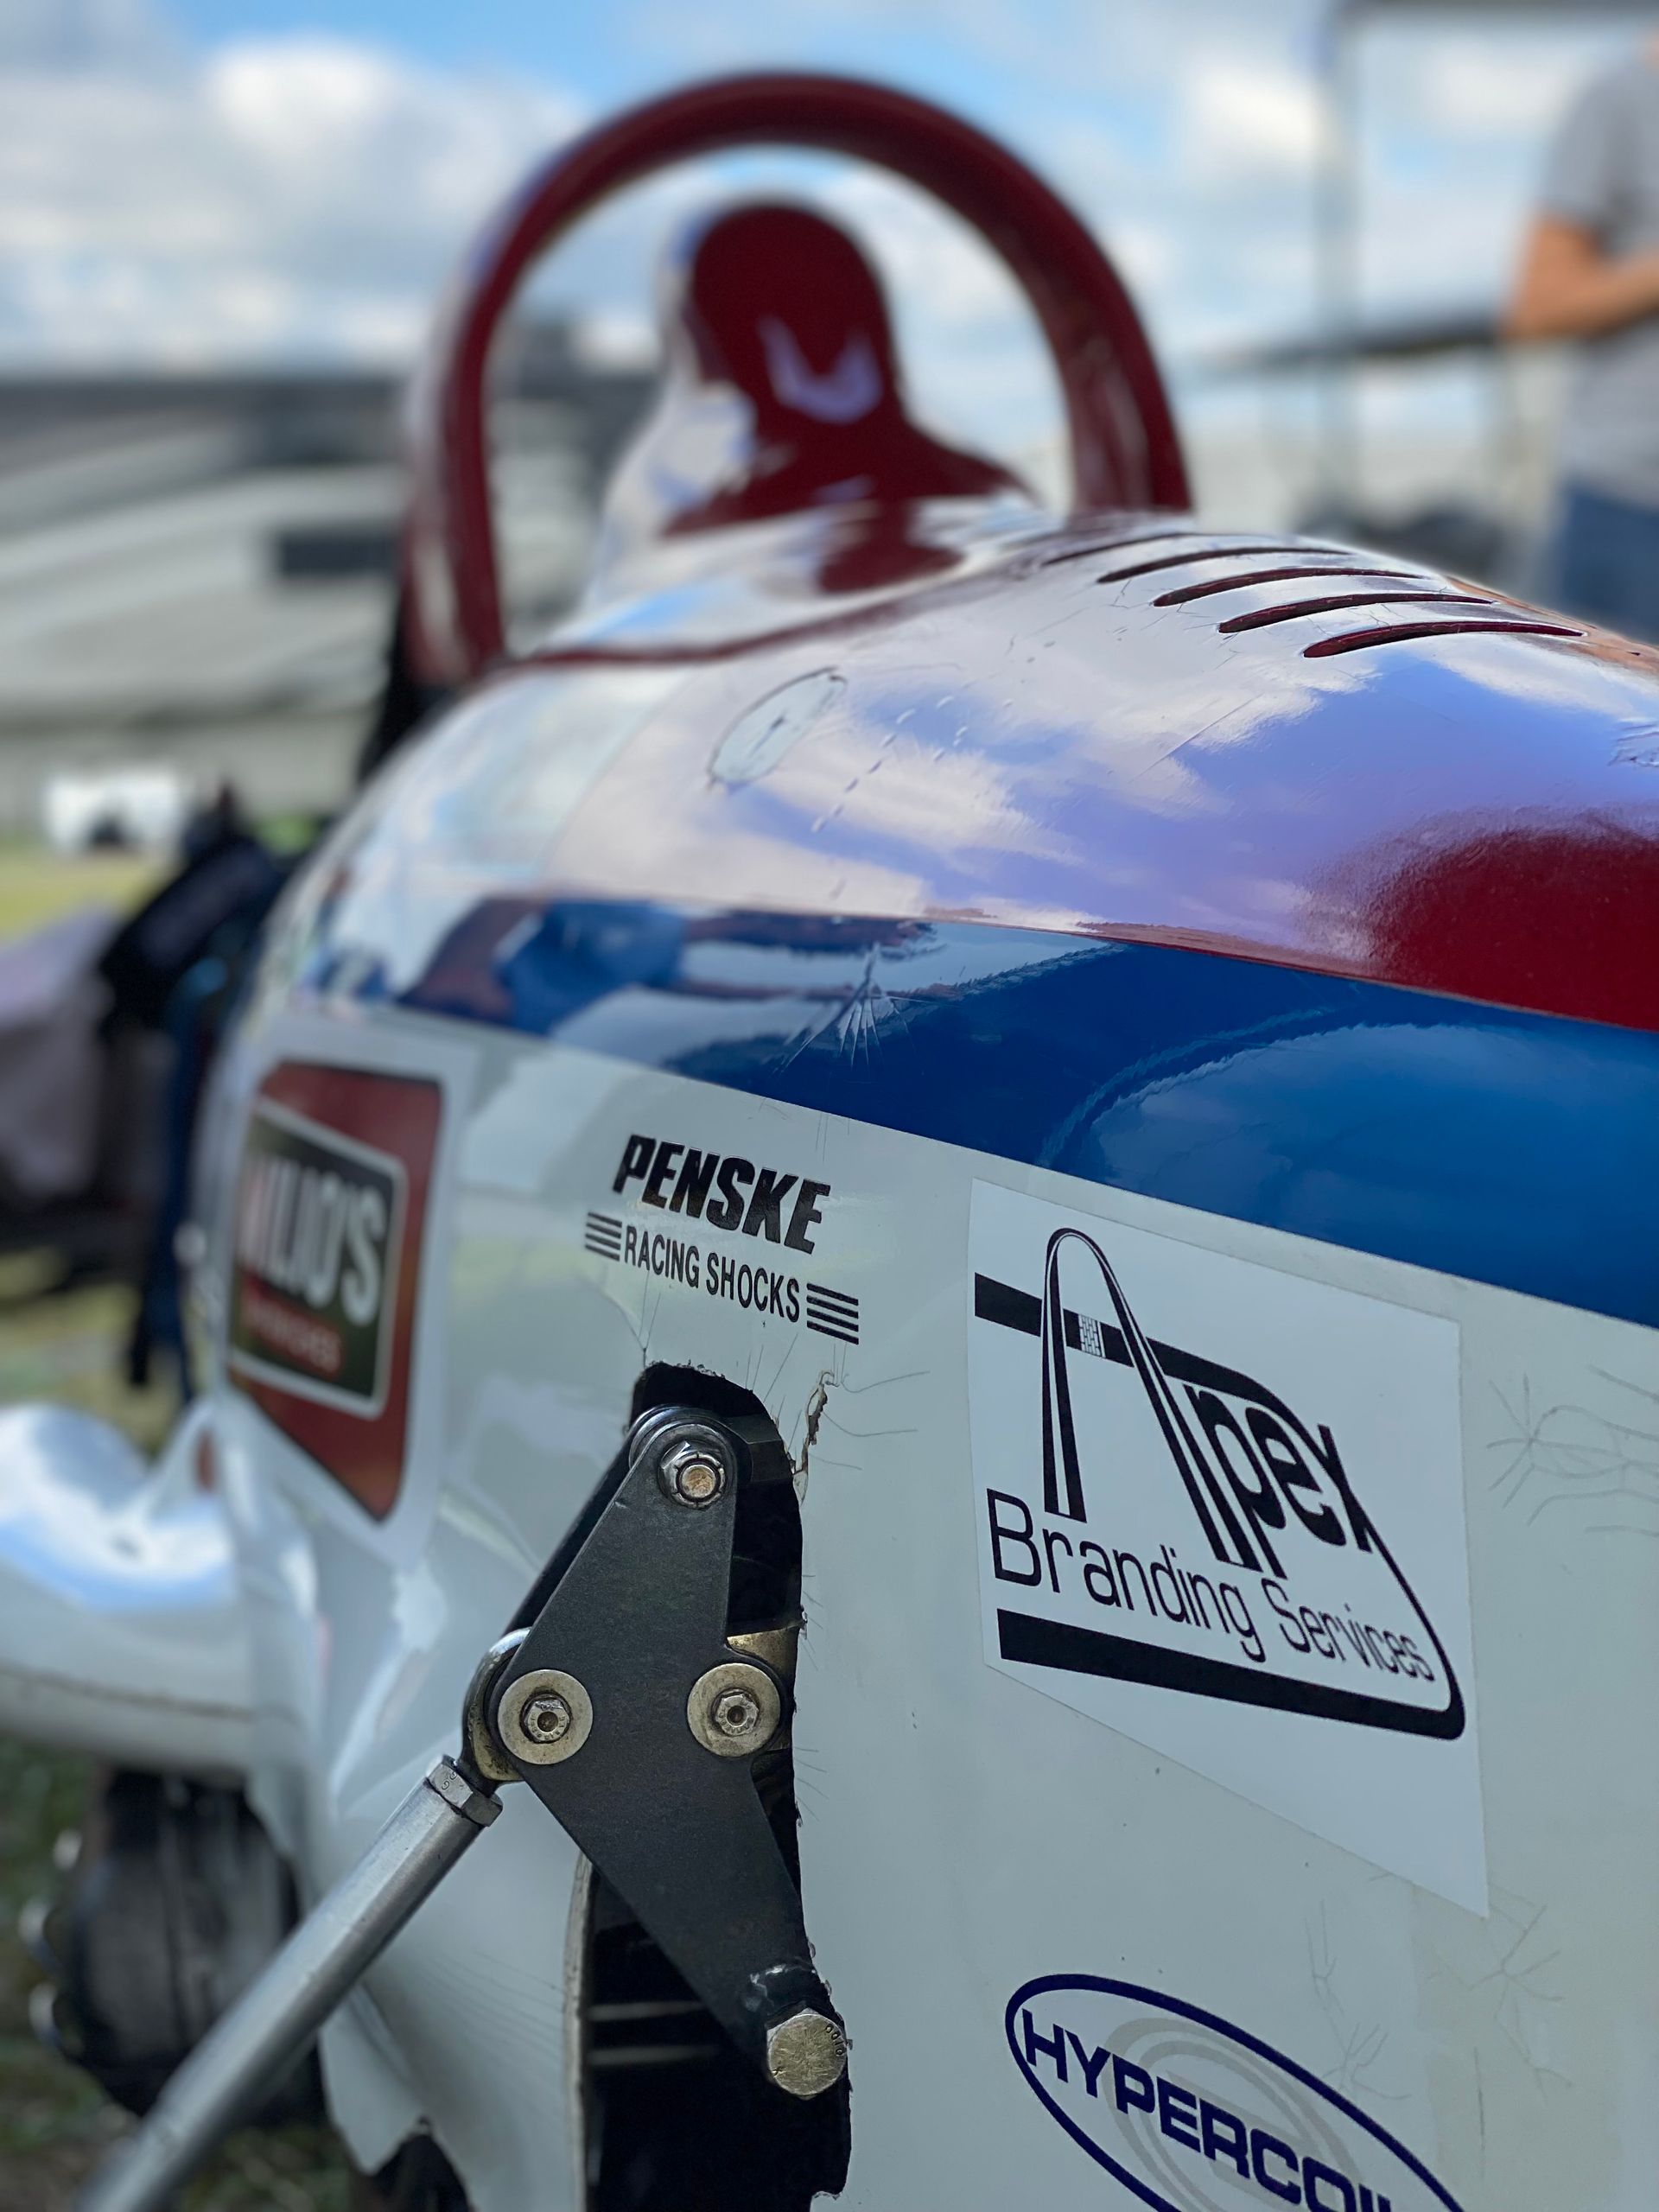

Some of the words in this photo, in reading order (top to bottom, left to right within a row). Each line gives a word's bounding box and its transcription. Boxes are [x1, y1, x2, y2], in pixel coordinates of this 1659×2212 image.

[613, 1134, 831, 1255] PENSKE
[624, 1225, 700, 1288] RACING
[706, 1252, 800, 1323] SHOCKS
[987, 1487, 1266, 1663] Branding
[1261, 1577, 1435, 1682] Services
